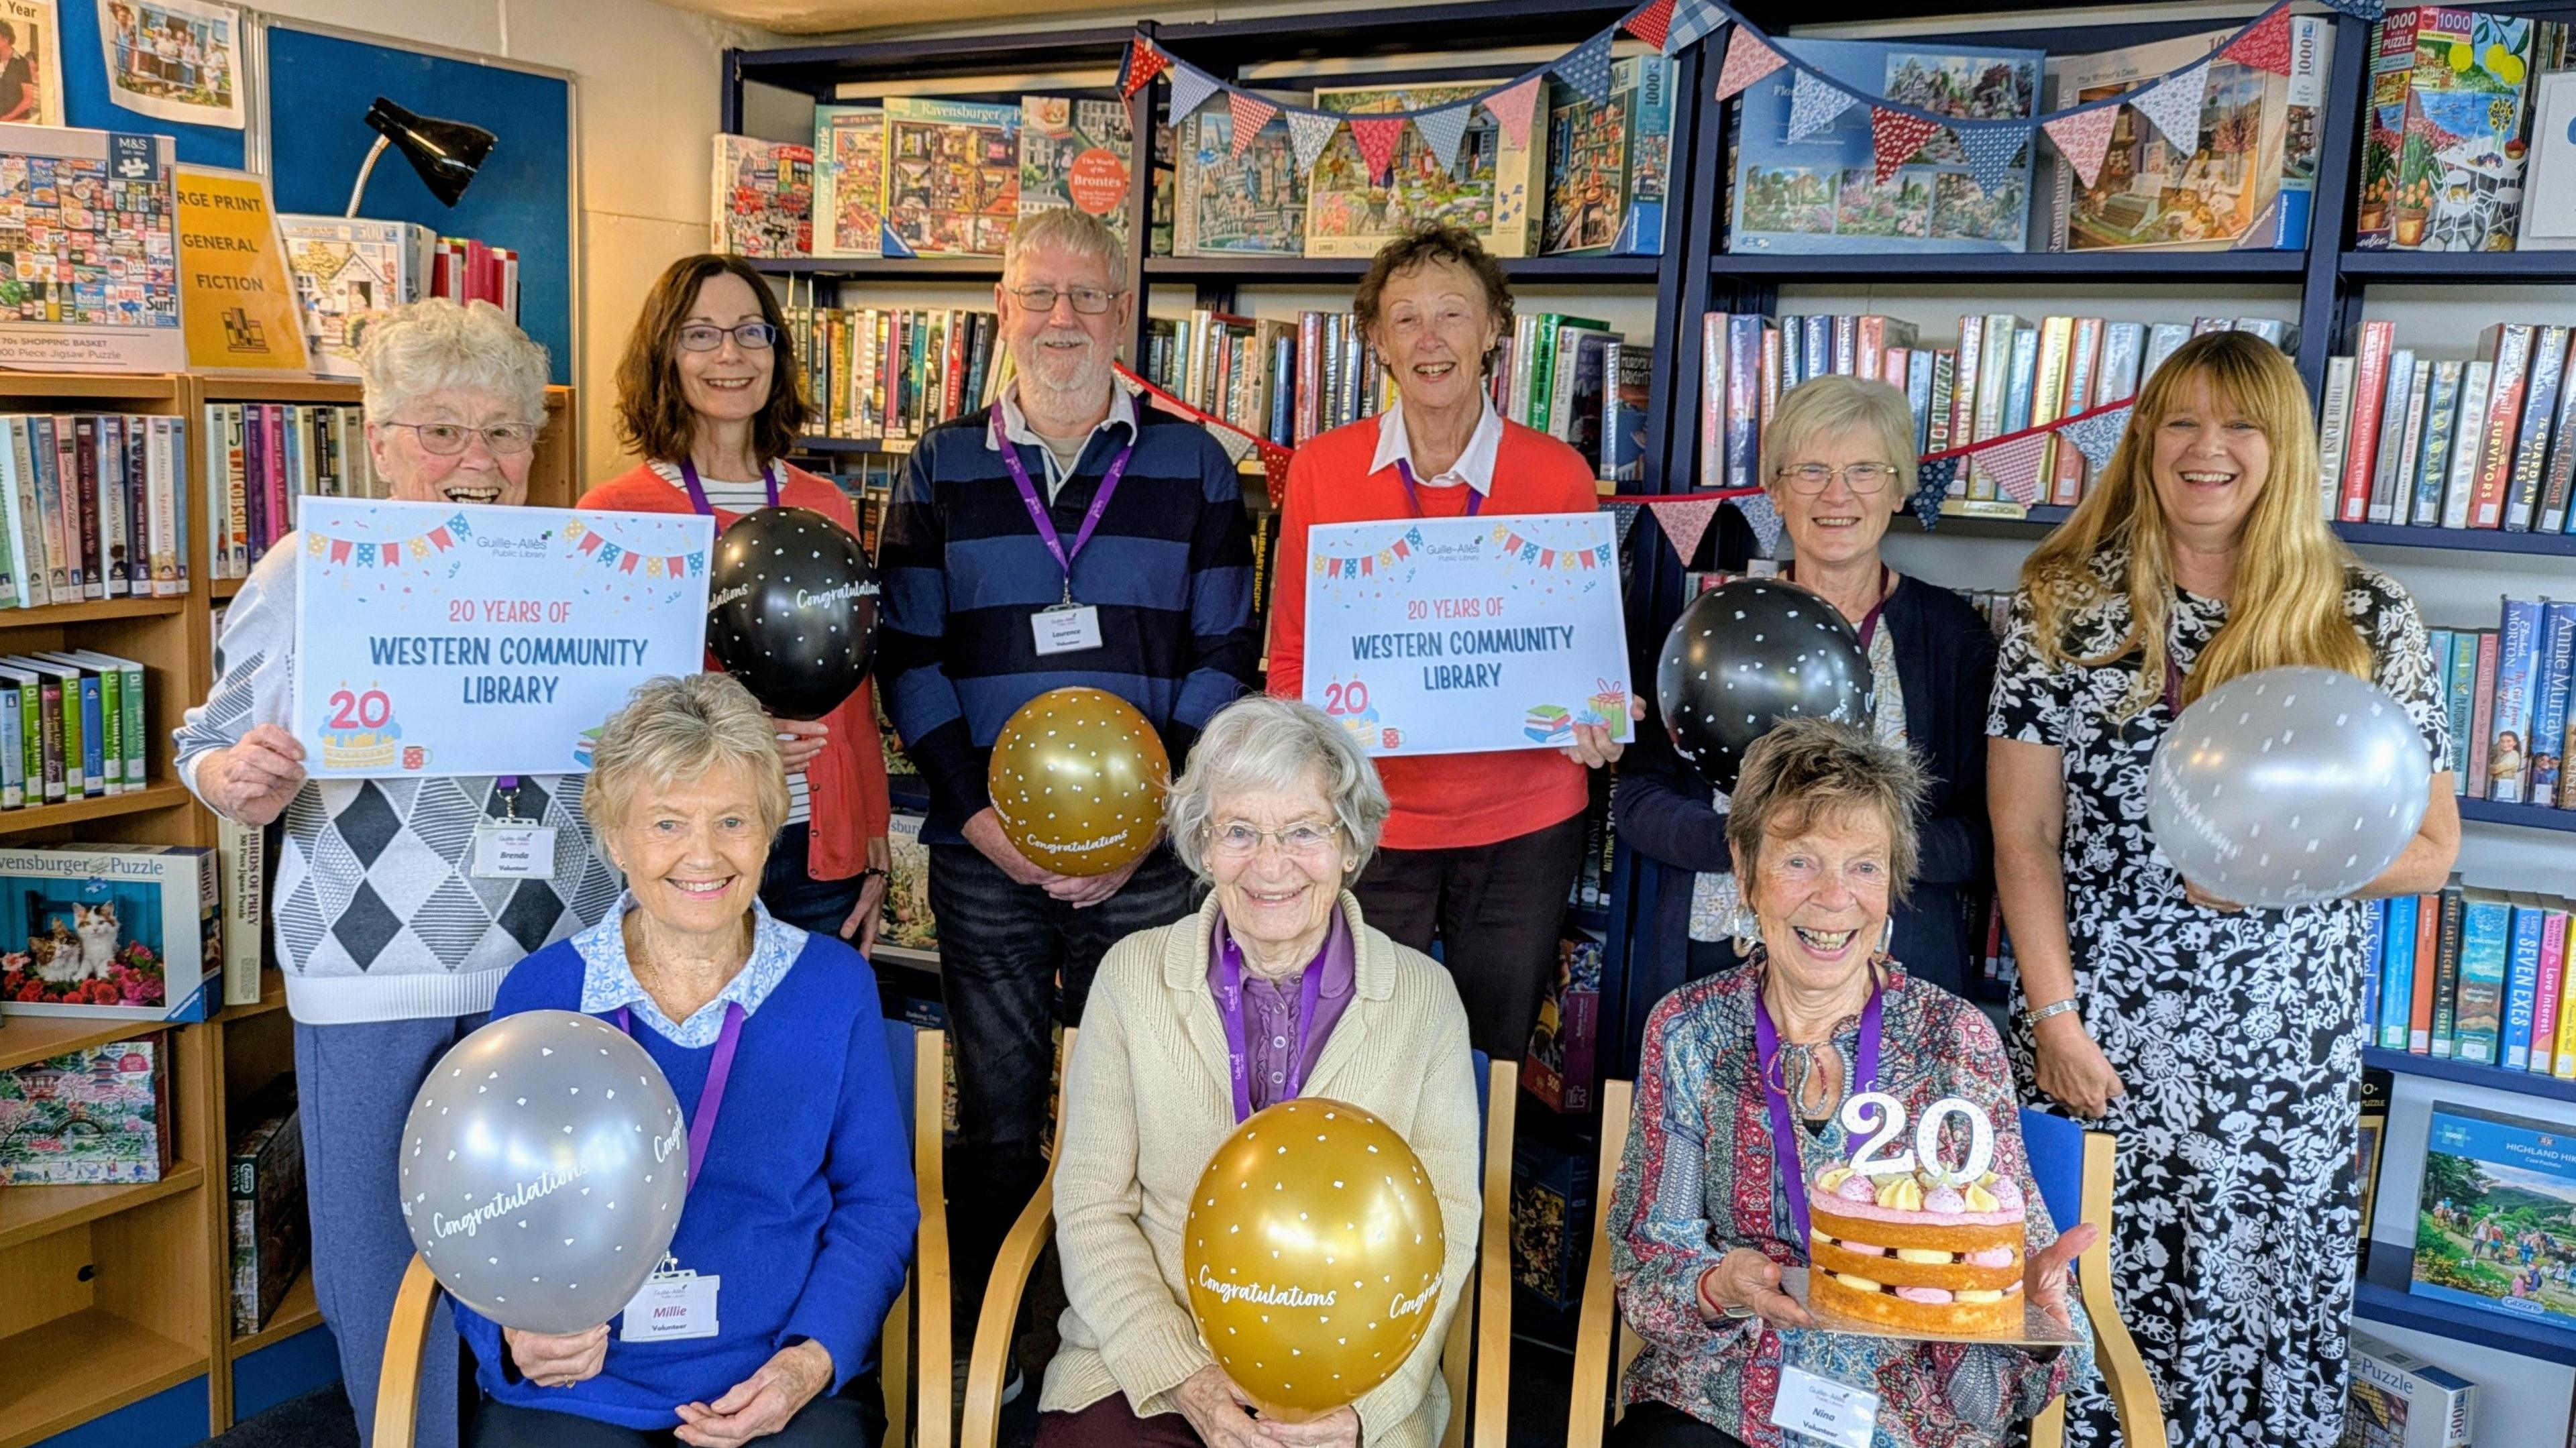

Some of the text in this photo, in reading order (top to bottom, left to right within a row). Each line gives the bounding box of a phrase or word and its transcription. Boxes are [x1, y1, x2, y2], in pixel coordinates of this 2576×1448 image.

[8, 1, 38, 17] Year
[2387, 11, 2416, 30] 1000
[2439, 13, 2471, 30] 1000
[2382, 35, 2413, 50] PUZZLE
[2299, 38, 2313, 76] 1000
[1646, 73, 1660, 107] 1000
[922, 102, 1000, 123] Ravensburger
[119, 138, 148, 150] M&S
[818, 127, 830, 164] Puzzle
[213, 194, 263, 213] PRINT
[2277, 193, 2290, 247] Ravensburger
[182, 233, 258, 254] GENERAL
[197, 274, 264, 292] FICTION
[146, 298, 176, 313] Surf
[19, 349, 122, 360] Piece Jigsaw Puzzle
[21, 338, 71, 347] SHOPPING
[72, 339, 107, 348] BASKET
[2408, 414, 2418, 441] AFRICAN
[2355, 422, 2371, 468] Patchwork
[2481, 420, 2504, 498] SURVIVORS
[2516, 439, 2531, 481] of LIES
[2523, 416, 2548, 504] The GUARDIAN
[2548, 451, 2571, 504] Lifeboat
[493, 549, 546, 560] Public Library
[1256, 532, 1267, 571] LIBRARY
[1438, 554, 1480, 563] Public Library
[449, 601, 572, 624] 20 YEARS OF
[1408, 596, 1505, 620] 20 YEARS OF
[1352, 625, 1575, 661] WESTERN COMMUNITY
[2504, 609, 2522, 668] MORTON
[2544, 614, 2559, 657] Homecoming
[369, 636, 649, 667] WESTERN COMMUNITY
[2483, 641, 2493, 661] LILAC
[2544, 658, 2553, 669] for
[1423, 662, 1503, 691] LIBRARY
[2481, 667, 2491, 691] MILLS
[2540, 614, 2573, 742] Annie Murray
[2544, 670, 2553, 681] the
[462, 675, 559, 704] LIBRARY
[1324, 681, 1369, 716] 20
[2498, 675, 2511, 720] Liverpool
[329, 689, 391, 729] 20
[113, 709, 121, 746] Victoria
[2565, 753, 2576, 794] NICHOLS
[1026, 828, 1128, 854] Congratulations
[110, 856, 164, 877] Puzzle
[500, 851, 530, 859] Brenda
[248, 832, 260, 927] BIRDS OF PREY
[2520, 914, 2530, 934] Vine
[2529, 915, 2539, 936] Lucy
[2546, 920, 2556, 947] WALTERS
[2553, 918, 2563, 949] VICTORIA
[2438, 895, 2457, 1035] EVERY LAST SECRET A. R. TORRE
[2511, 938, 2538, 1027] SEVEN EXES
[2539, 967, 2559, 1034] Love Interest
[1547, 1073, 1560, 1095] 500
[1840, 1091, 1994, 1184] 20
[2445, 1131, 2463, 1139] 1000
[2506, 1142, 2559, 1160] HIGHLAND
[433, 1164, 590, 1237] Congratulations
[1199, 1264, 1337, 1308] Congratulations
[653, 1305, 688, 1319] Millie
[2504, 1298, 2540, 1313] Gibsons
[651, 1323, 688, 1331] Volunteer
[2362, 1356, 2414, 1394] Puzzle
[1812, 1407, 1836, 1422] Nina
[2450, 1407, 2465, 1439] 500
[1803, 1420, 1839, 1438] Volunteer
